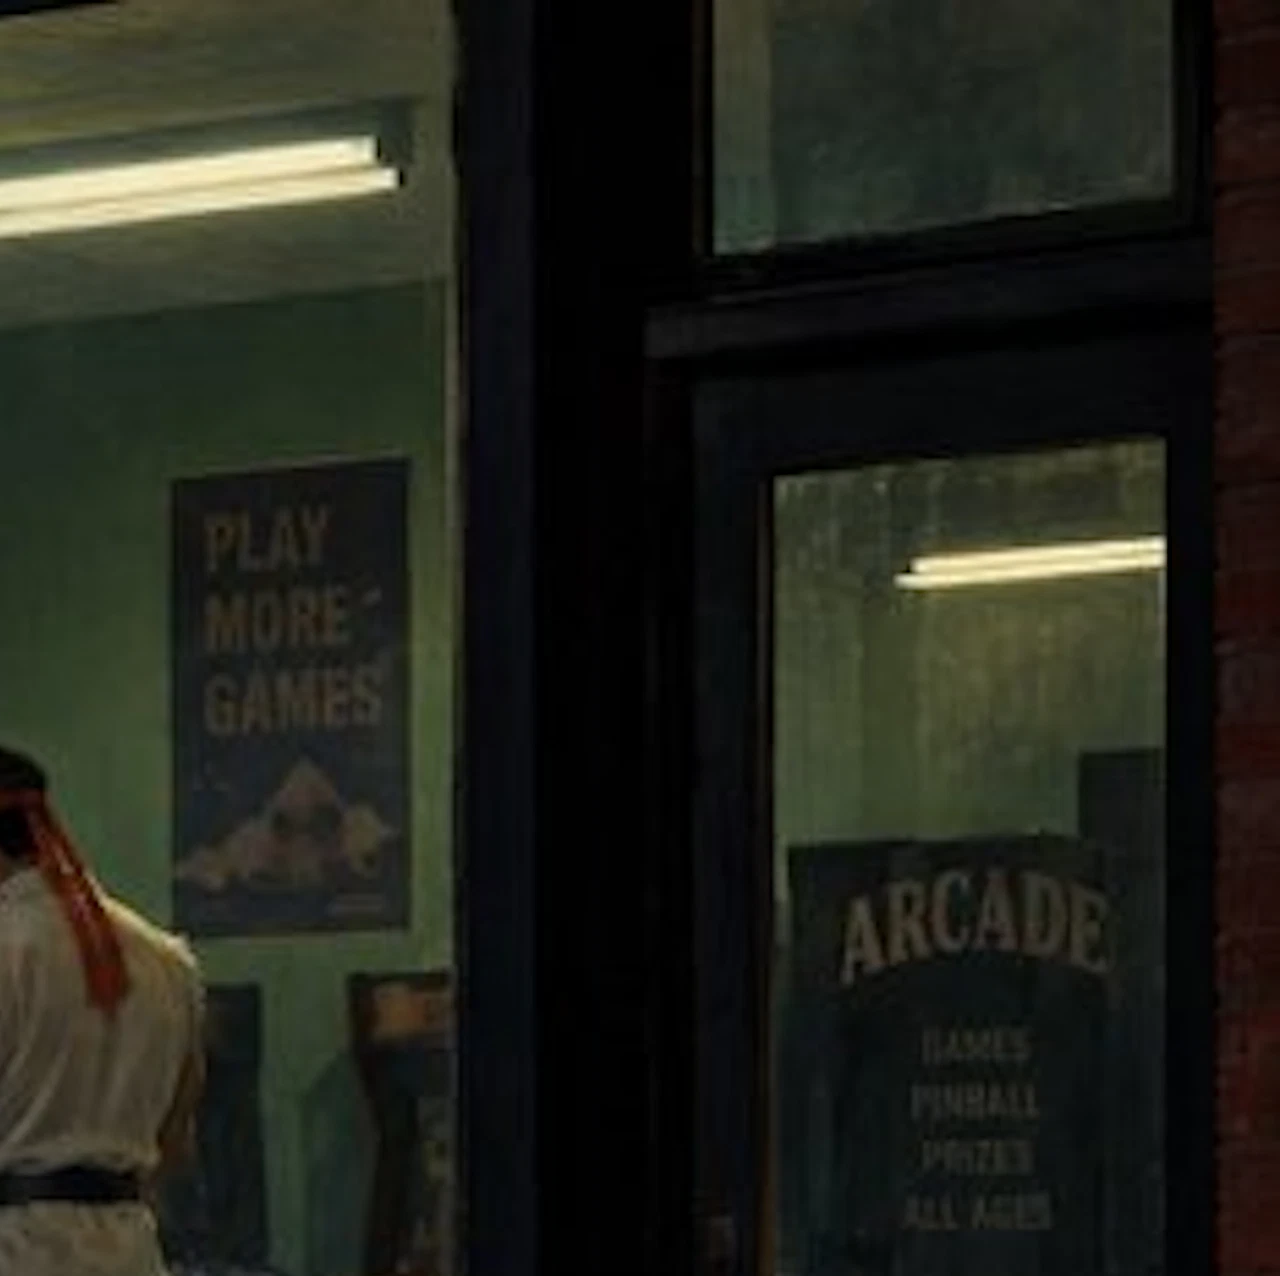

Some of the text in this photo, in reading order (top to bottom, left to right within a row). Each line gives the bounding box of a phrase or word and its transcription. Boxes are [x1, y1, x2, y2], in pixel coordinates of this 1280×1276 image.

[202, 504, 331, 574] PLAY
[203, 666, 385, 736] GAMES
[839, 865, 1117, 987] ARCADE
[909, 1082, 1041, 1122] PINBALL
[900, 1192, 959, 1231] ALL
